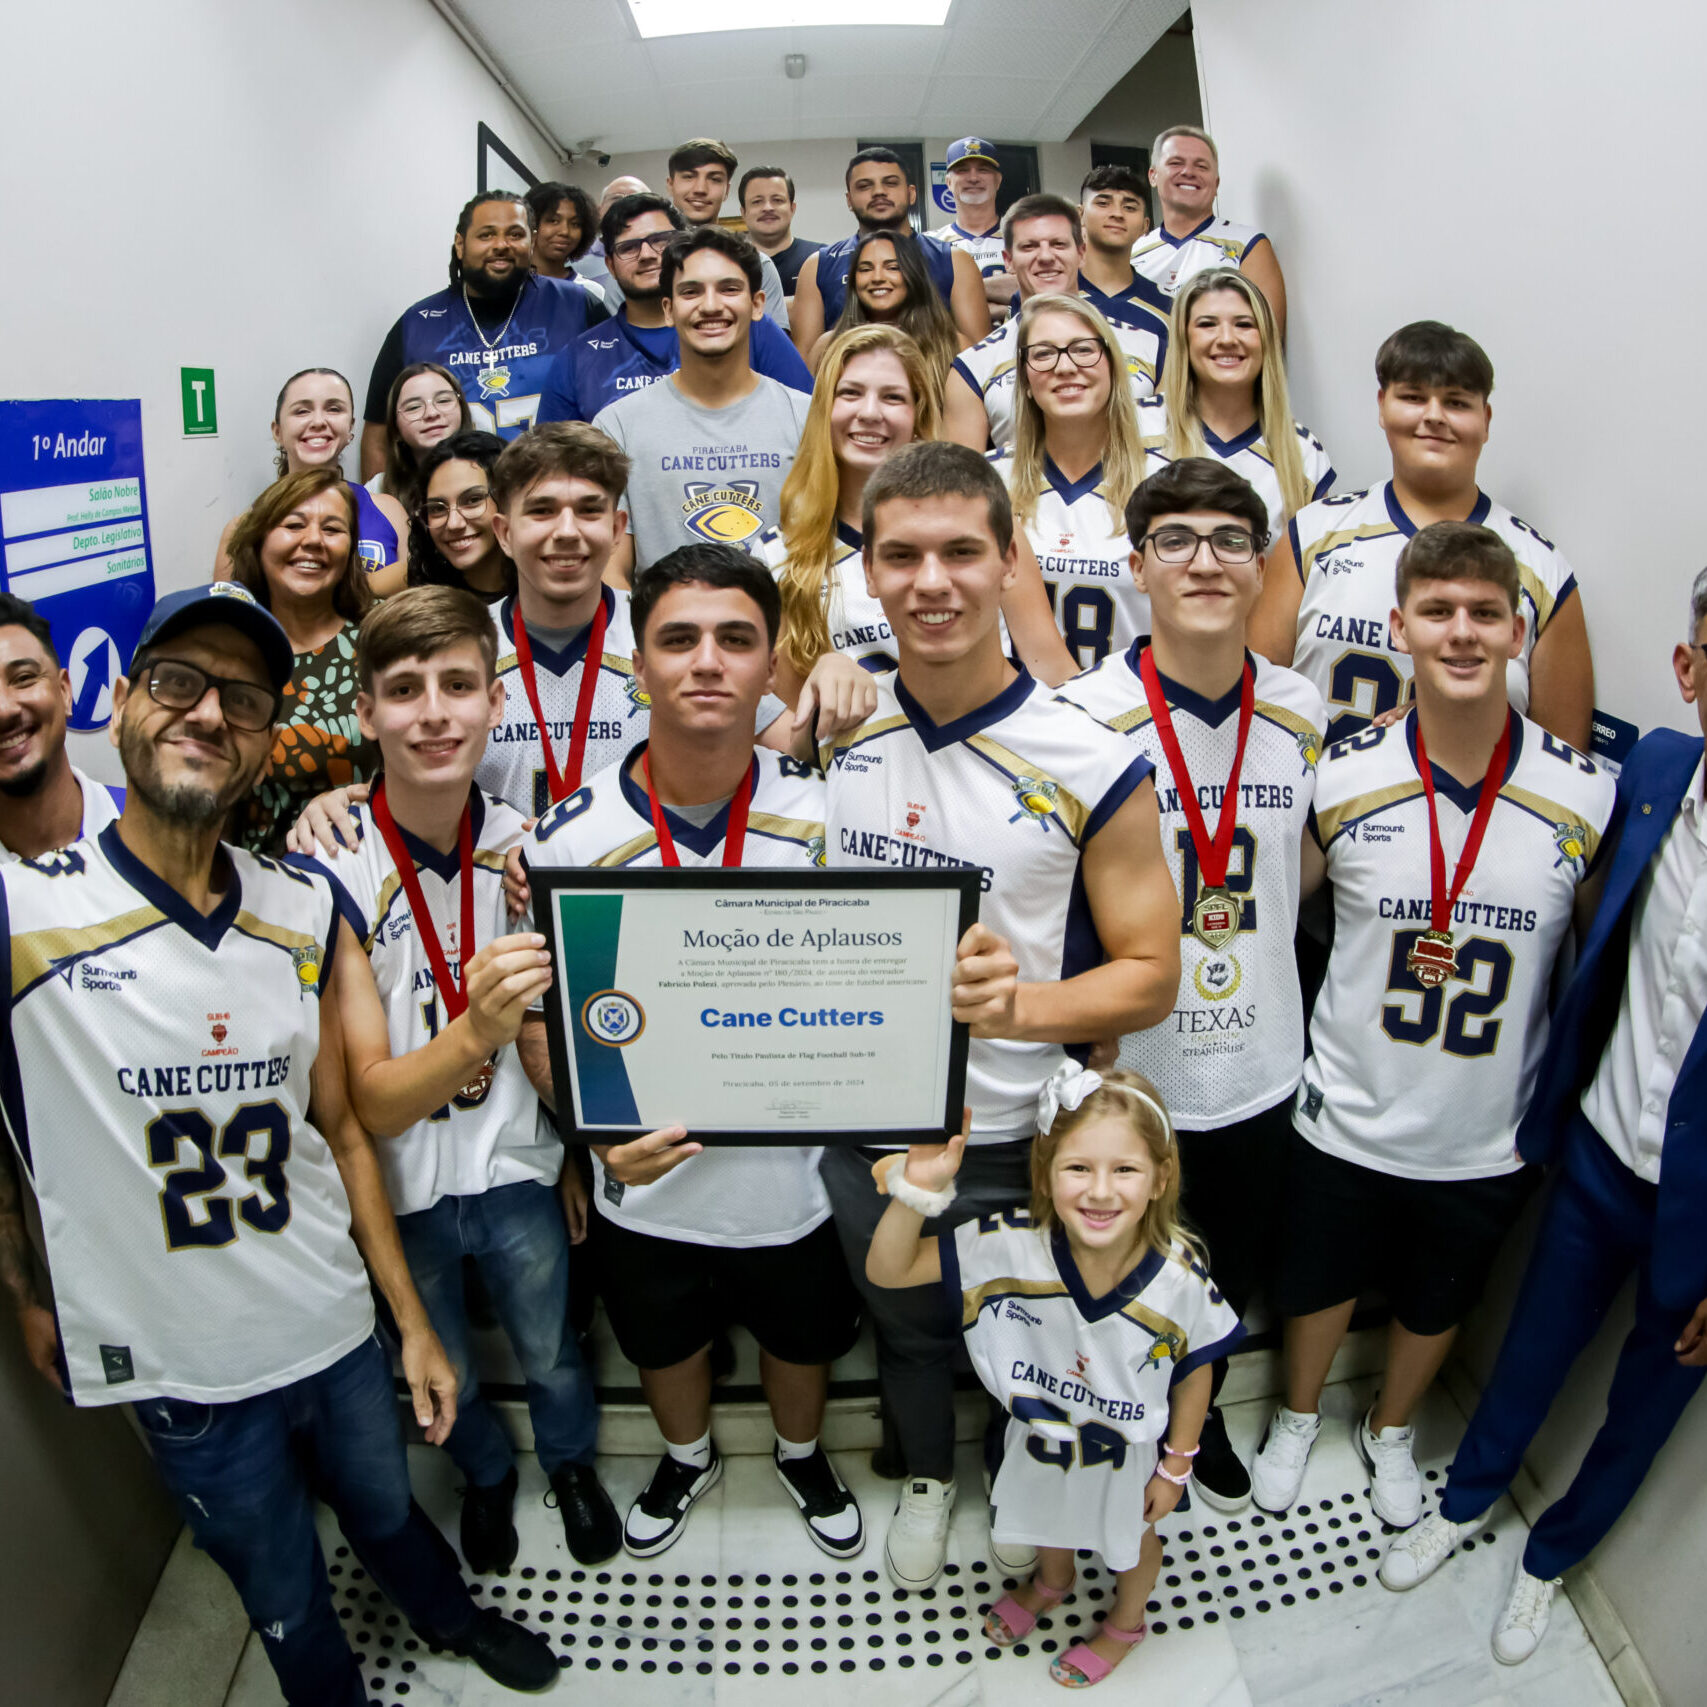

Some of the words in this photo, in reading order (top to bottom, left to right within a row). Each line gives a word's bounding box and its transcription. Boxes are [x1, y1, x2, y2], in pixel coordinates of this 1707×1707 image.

[450, 351, 480, 366] CANE
[53, 429, 107, 459] Andar
[692, 444, 749, 455] PIRACICABA
[661, 456, 704, 471] CANE
[707, 453, 780, 471] CUTTERS
[89, 487, 112, 502] Salão
[114, 485, 138, 498] Nobre
[682, 493, 710, 513] CANE
[713, 491, 762, 512] CUTTERS
[73, 535, 101, 551] Depto.
[102, 528, 142, 546] Legislativo
[107, 554, 145, 575] Sanitários
[1046, 557, 1120, 577] CUTTERS
[832, 625, 878, 650] CANE
[1316, 614, 1382, 649] CANE
[492, 722, 540, 743] CANE
[545, 720, 622, 741] CUTERS
[844, 761, 869, 773] Sports
[847, 751, 883, 765] Surmount
[1198, 784, 1294, 811] CUTERS
[1362, 833, 1392, 843] Sports
[1363, 823, 1405, 833] Surmount
[841, 827, 888, 862] CANE
[715, 899, 753, 908] Câmara
[755, 899, 802, 909] Municipal
[805, 898, 817, 907] de
[819, 898, 870, 908] Piracicaba
[1379, 897, 1433, 921] CANE
[1450, 901, 1537, 932] UTTERS
[683, 928, 760, 952] Moção
[766, 928, 794, 948] de
[800, 928, 903, 952] Aplausos
[81, 963, 138, 980] Surmount
[81, 975, 123, 992] Sports
[1379, 928, 1516, 1059] 52
[700, 1007, 773, 1028] Cane
[779, 1007, 885, 1027] Cutters
[1173, 1004, 1256, 1034] TEXAS
[787, 1051, 797, 1060] de
[1182, 1042, 1246, 1057] STEAKHOUSE
[117, 1066, 192, 1097] CANE
[196, 1054, 291, 1094] CUTTERS
[144, 1097, 292, 1254] 23
[1011, 1361, 1058, 1394] CANE
[1060, 1381, 1145, 1421] CUTTERS
